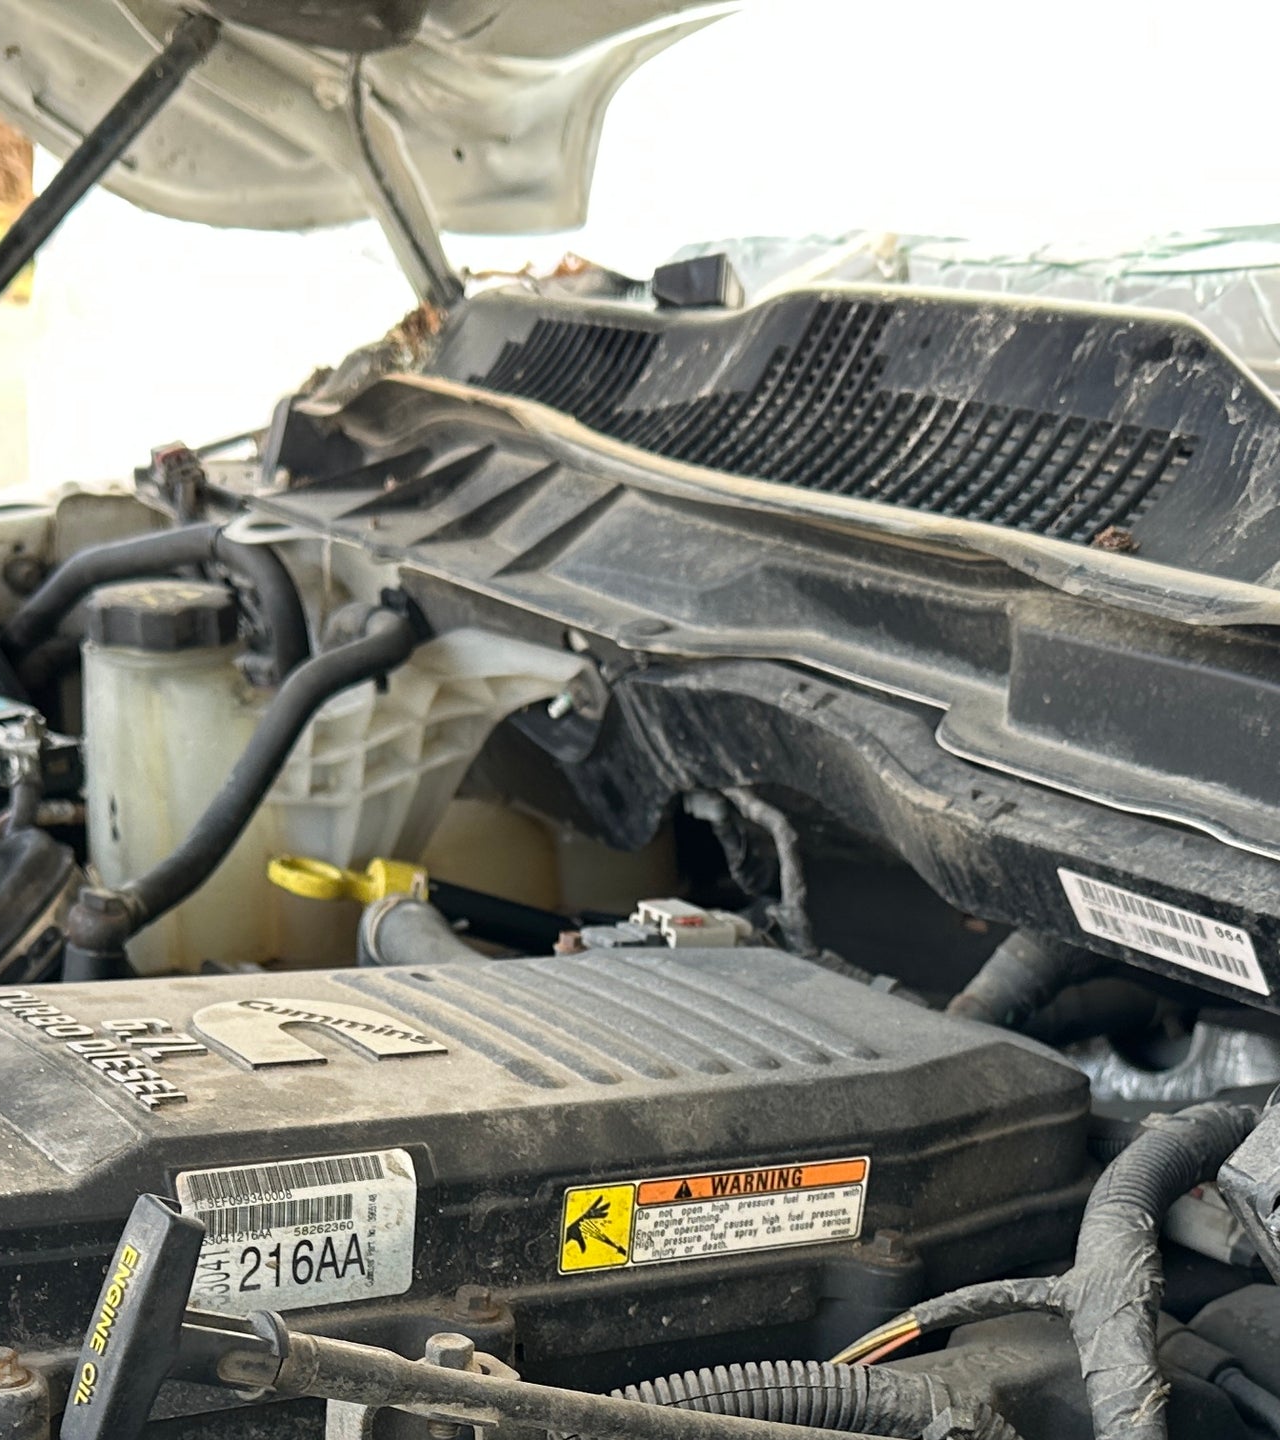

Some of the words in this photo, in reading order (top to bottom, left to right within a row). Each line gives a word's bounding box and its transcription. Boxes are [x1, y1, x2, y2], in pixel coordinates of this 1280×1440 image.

[237, 998, 435, 1046] Cummins
[100, 1017, 209, 1062] 6.7L
[65, 1037, 188, 1111] DIESEL
[711, 1168, 803, 1196] WARNING
[638, 1210, 650, 1220] Do
[659, 1208, 673, 1218] not
[682, 1206, 703, 1217] open
[711, 1202, 730, 1213] high
[738, 1198, 775, 1211] pressure
[783, 1194, 799, 1204] fuel
[807, 1191, 835, 1203] system
[843, 1188, 860, 1197] with
[294, 1220, 354, 1237] 58262360
[635, 1239, 655, 1250] High
[664, 1234, 702, 1248] pressure
[711, 1230, 726, 1240] fuel
[735, 1228, 758, 1239] spray
[766, 1225, 781, 1234] can
[790, 1222, 814, 1231] cause
[822, 1217, 851, 1227] serious
[636, 1228, 666, 1240] Engine
[674, 1223, 715, 1236] operation
[724, 1218, 753, 1230] causes
[762, 1214, 780, 1225] high
[788, 1211, 804, 1221] fuel
[654, 1218, 683, 1229] engine
[239, 1233, 366, 1293] 216AA
[652, 1247, 676, 1257] injury
[684, 1245, 694, 1254] or
[89, 1244, 139, 1356] ENGINE
[73, 1362, 96, 1405] OIL
